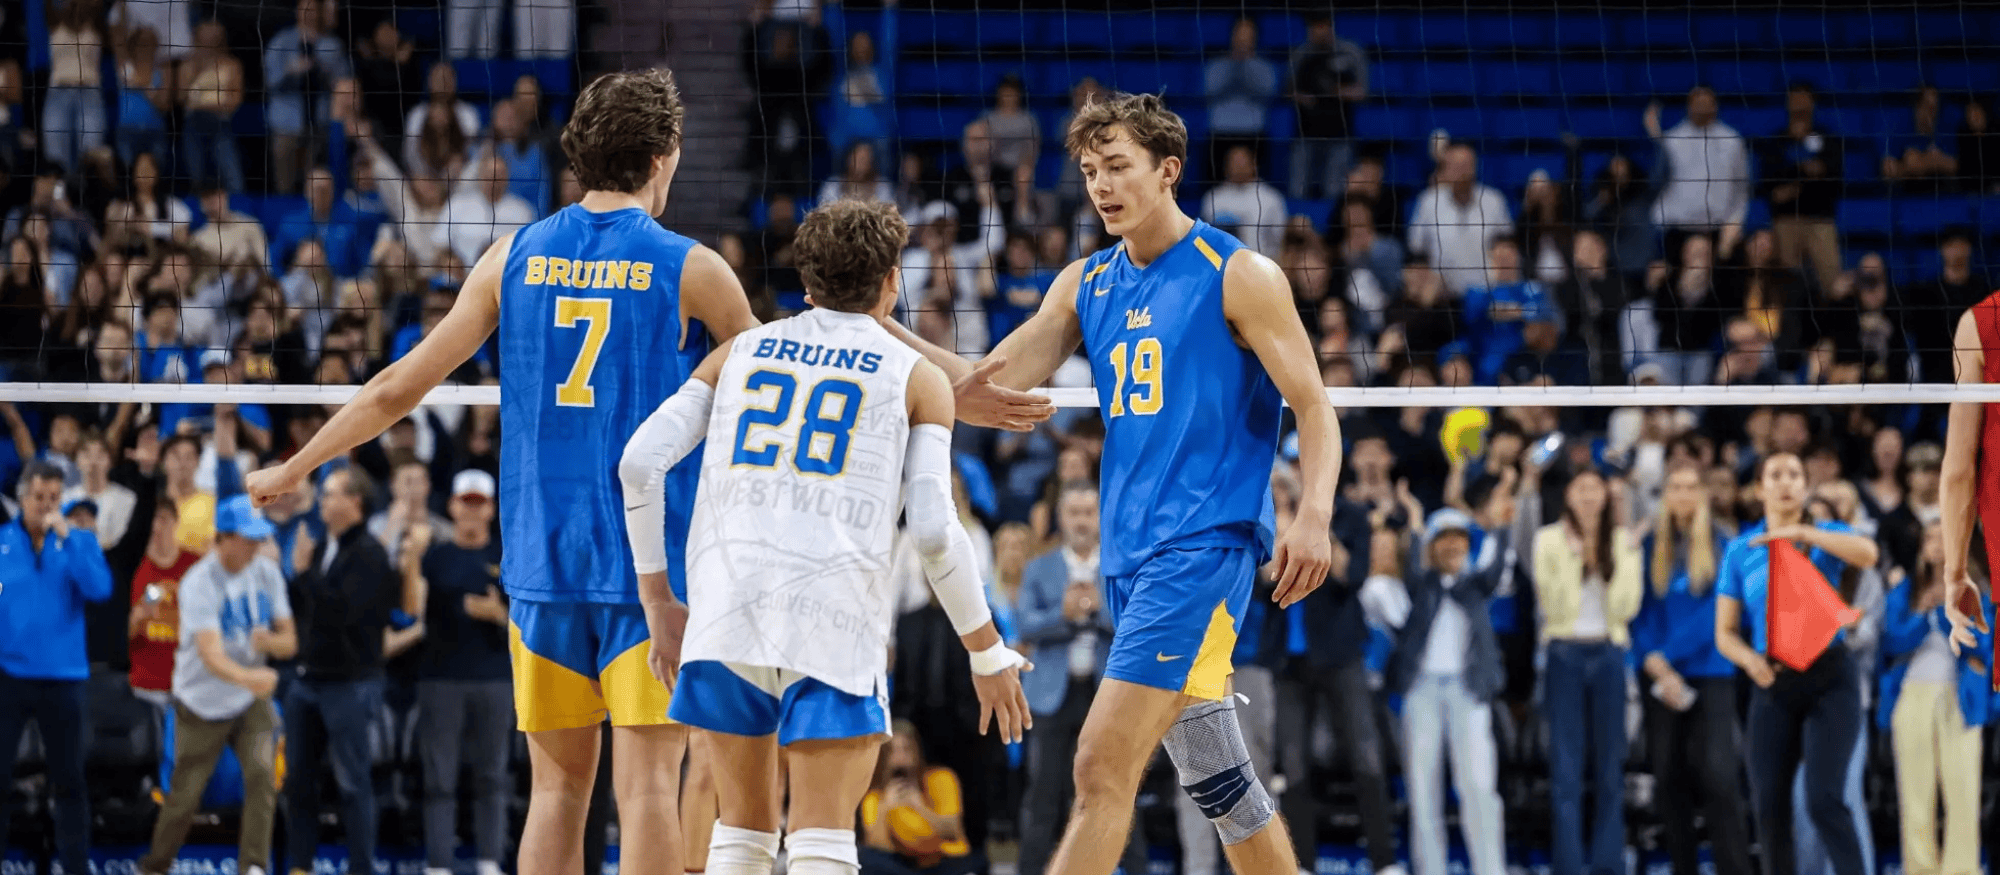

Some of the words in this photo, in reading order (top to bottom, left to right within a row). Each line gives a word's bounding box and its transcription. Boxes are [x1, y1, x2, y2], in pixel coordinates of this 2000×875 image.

[524, 255, 654, 291] BRUINS
[554, 296, 612, 407] 7
[752, 338, 883, 374] BRUINS
[1109, 337, 1164, 418] 19
[729, 365, 867, 481] 28
[716, 478, 875, 530] WESTWOOD
